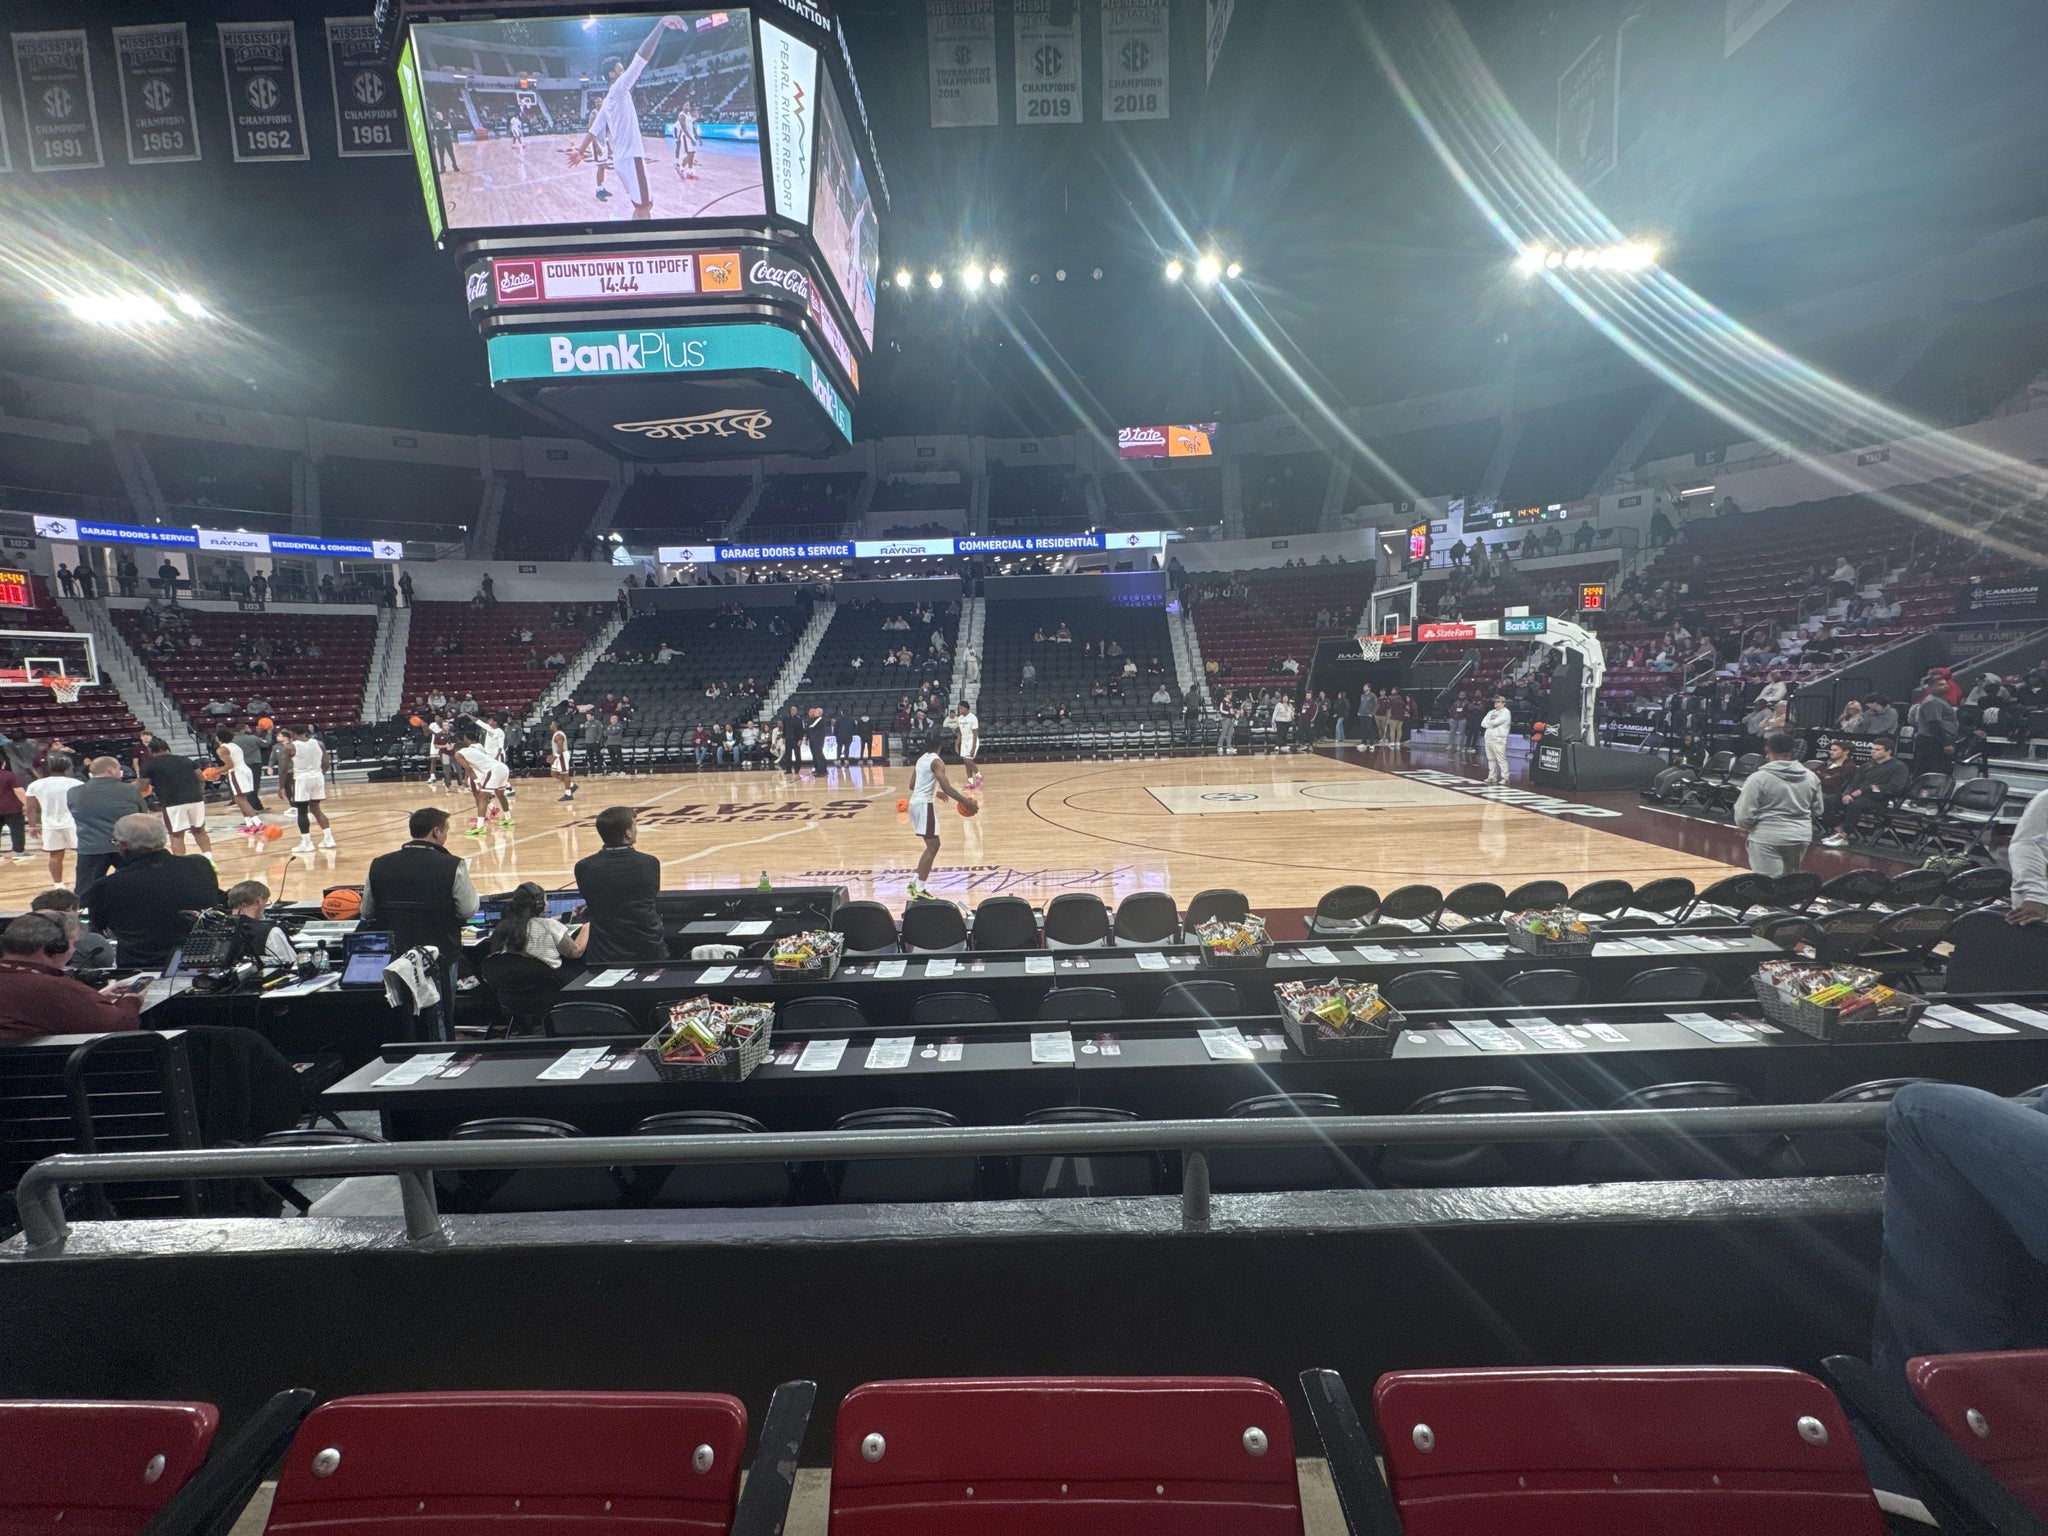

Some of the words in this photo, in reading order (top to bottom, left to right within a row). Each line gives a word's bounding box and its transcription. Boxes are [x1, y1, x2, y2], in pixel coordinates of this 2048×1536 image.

[776, 0, 831, 32] DATION
[954, 45, 972, 65] SEC
[1034, 46, 1063, 77] SEC
[1121, 41, 1150, 72] SEC
[780, 39, 790, 92] PEARL
[353, 71, 385, 104] SEC
[1022, 83, 1076, 93] CHAMPIONS
[1108, 78, 1163, 89] CHAMPIONS
[143, 79, 172, 112] SEC
[247, 76, 281, 110] SEC
[43, 85, 73, 119] SEC
[1027, 98, 1071, 117] 2019
[135, 116, 186, 128] CHAMPIONS
[237, 114, 293, 126] CHAMPIONS
[344, 108, 398, 120] CHAMPIONS
[781, 99, 791, 143] RIVER
[142, 131, 184, 151] 1963
[247, 130, 292, 150] 1962
[352, 124, 392, 144] 1961
[43, 139, 83, 159] 1991
[782, 147, 793, 211] RESORT
[547, 261, 625, 279] COUNTDOWN
[627, 260, 646, 275] TO
[648, 258, 690, 275] TIPOFF
[500, 271, 535, 293] State
[600, 276, 639, 293] 14:44
[550, 331, 707, 373] BankPlus
[612, 408, 773, 440] State
[1118, 427, 1166, 448] State
[1705, 451, 1715, 463] E
[1401, 502, 1409, 512] D
[1559, 509, 1567, 519] 0
[1496, 518, 1503, 527] 0
[81, 527, 118, 538] GARAGE
[119, 530, 151, 541] DOORS
[151, 532, 158, 541] &
[159, 533, 196, 543] SERVICE
[959, 538, 1020, 551] COMMERCIAL
[1022, 537, 1031, 549] &
[1033, 535, 1099, 549] RESIDENTIAL
[9, 540, 29, 548] 102
[272, 541, 318, 551] RESIDENTIAL
[319, 544, 326, 552] &
[326, 544, 373, 554] COMMERCIAL
[721, 548, 761, 559] GARAGE
[762, 547, 796, 558] DOORS
[797, 546, 805, 557] &
[807, 545, 849, 557] SERVICE
[880, 543, 926, 556] RAYNOR
[0, 572, 25, 585] :44
[1985, 586, 2039, 596] CAMGIAN
[244, 602, 260, 610] 103
[1585, 596, 1599, 608] 30
[1505, 621, 1544, 632] BankPlus
[1337, 650, 1403, 659] BANRST
[1830, 738, 1874, 748] CGIA
[556, 811, 860, 829] MISSISSIPI
